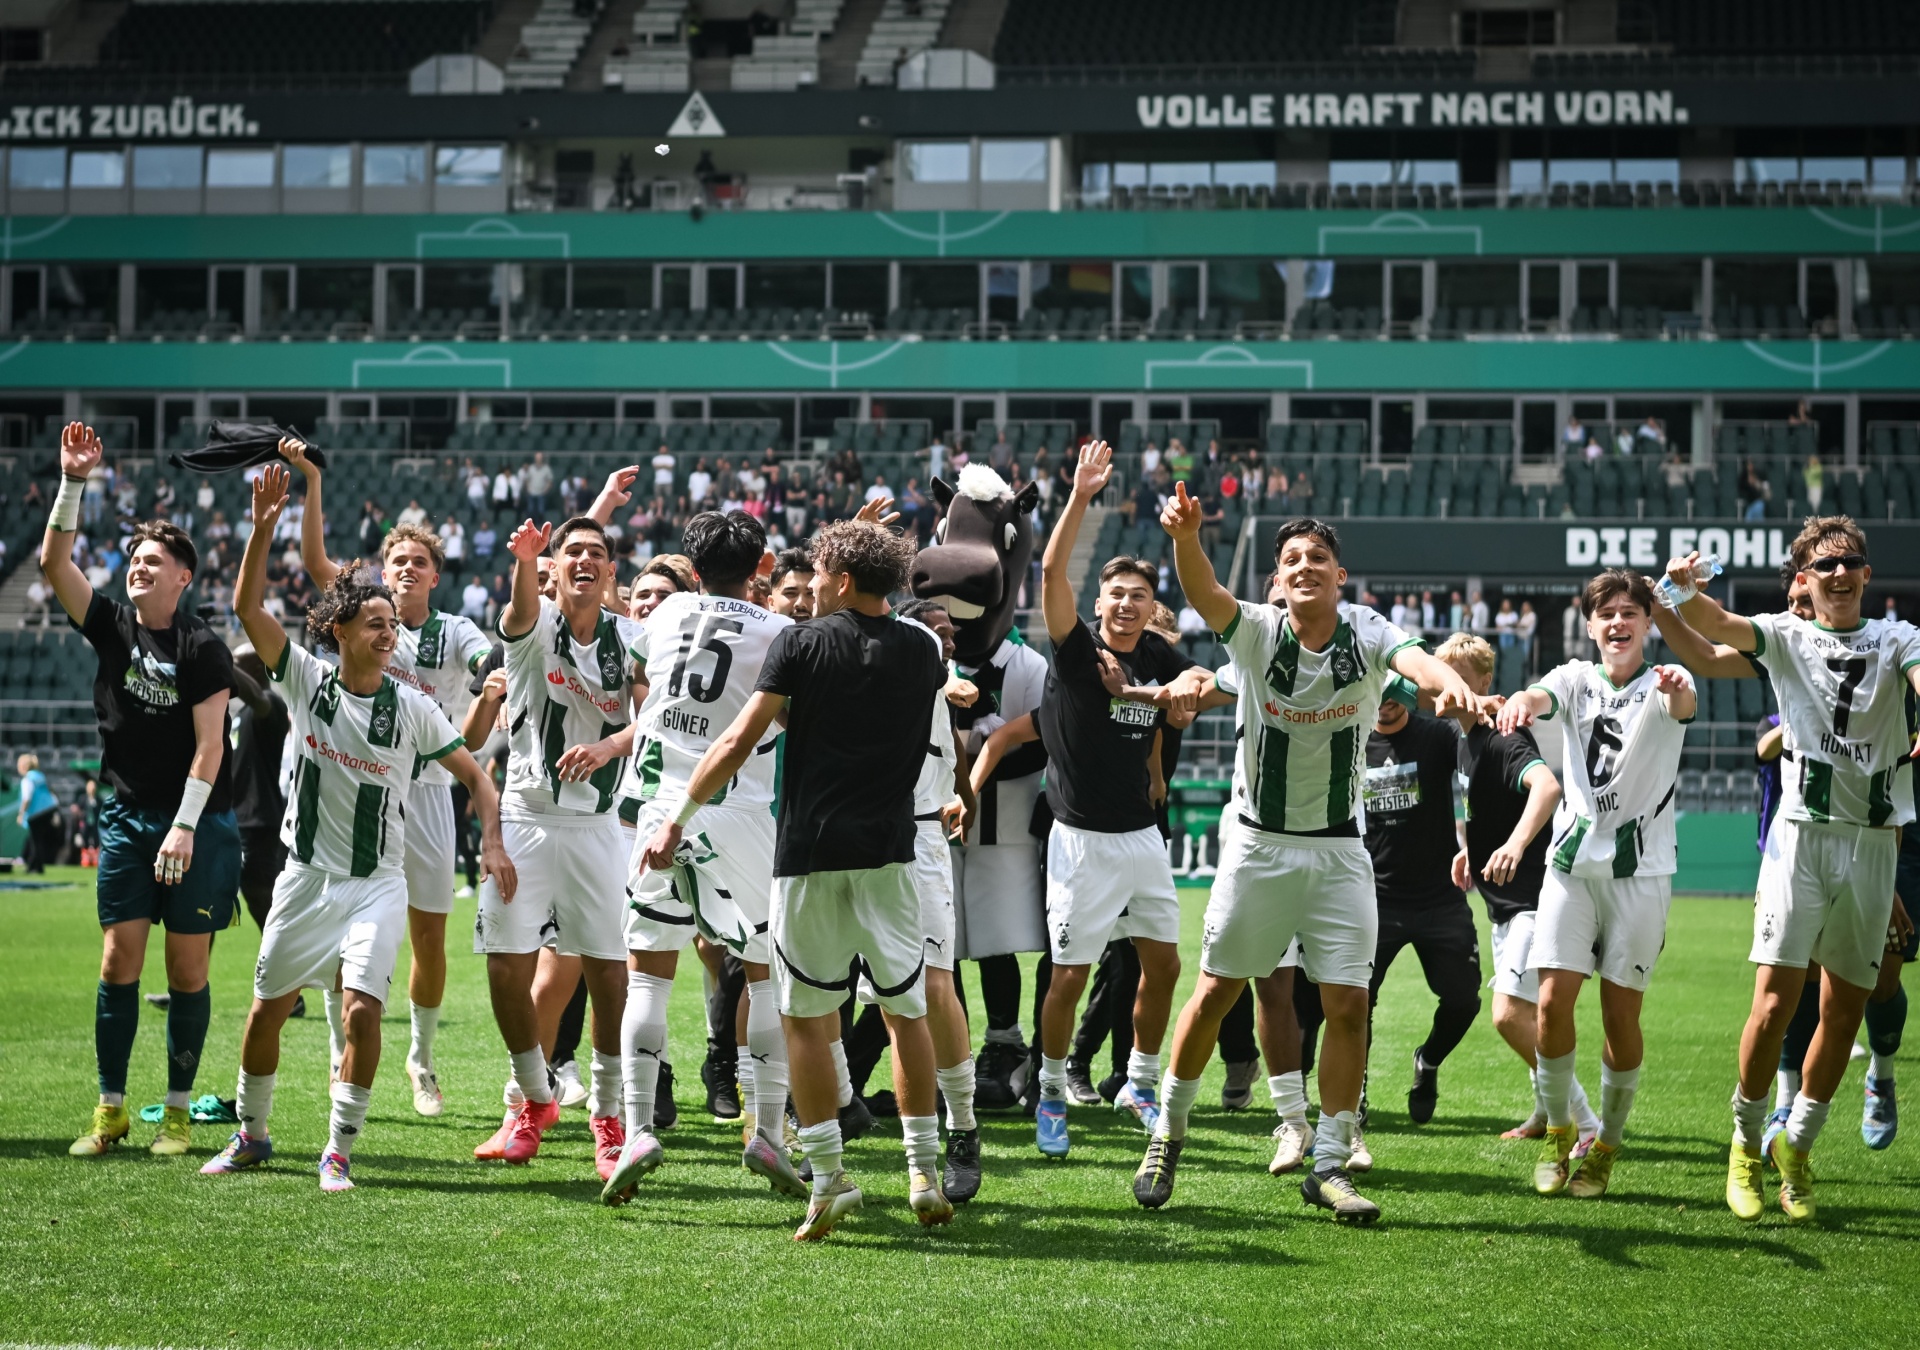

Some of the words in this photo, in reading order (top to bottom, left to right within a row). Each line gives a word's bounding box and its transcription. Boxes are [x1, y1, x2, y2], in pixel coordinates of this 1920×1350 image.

[90, 96, 260, 137] ZURÜCK.
[1137, 95, 1274, 127] VOLLE
[1284, 94, 1422, 126] KRAFT
[1432, 92, 1544, 125] NACH
[1554, 91, 1690, 124] VORN.
[1566, 527, 1658, 566] DIE
[668, 612, 744, 703] 15
[130, 680, 170, 705] MEISTER
[566, 677, 622, 713] Santde
[1827, 658, 1867, 738] 7
[663, 707, 709, 737] GÜNER
[1283, 702, 1361, 724] Santander
[318, 742, 391, 776] Santander
[1586, 714, 1624, 788] 6
[1370, 793, 1410, 812] MEISTER
[1592, 791, 1619, 813] HIC
